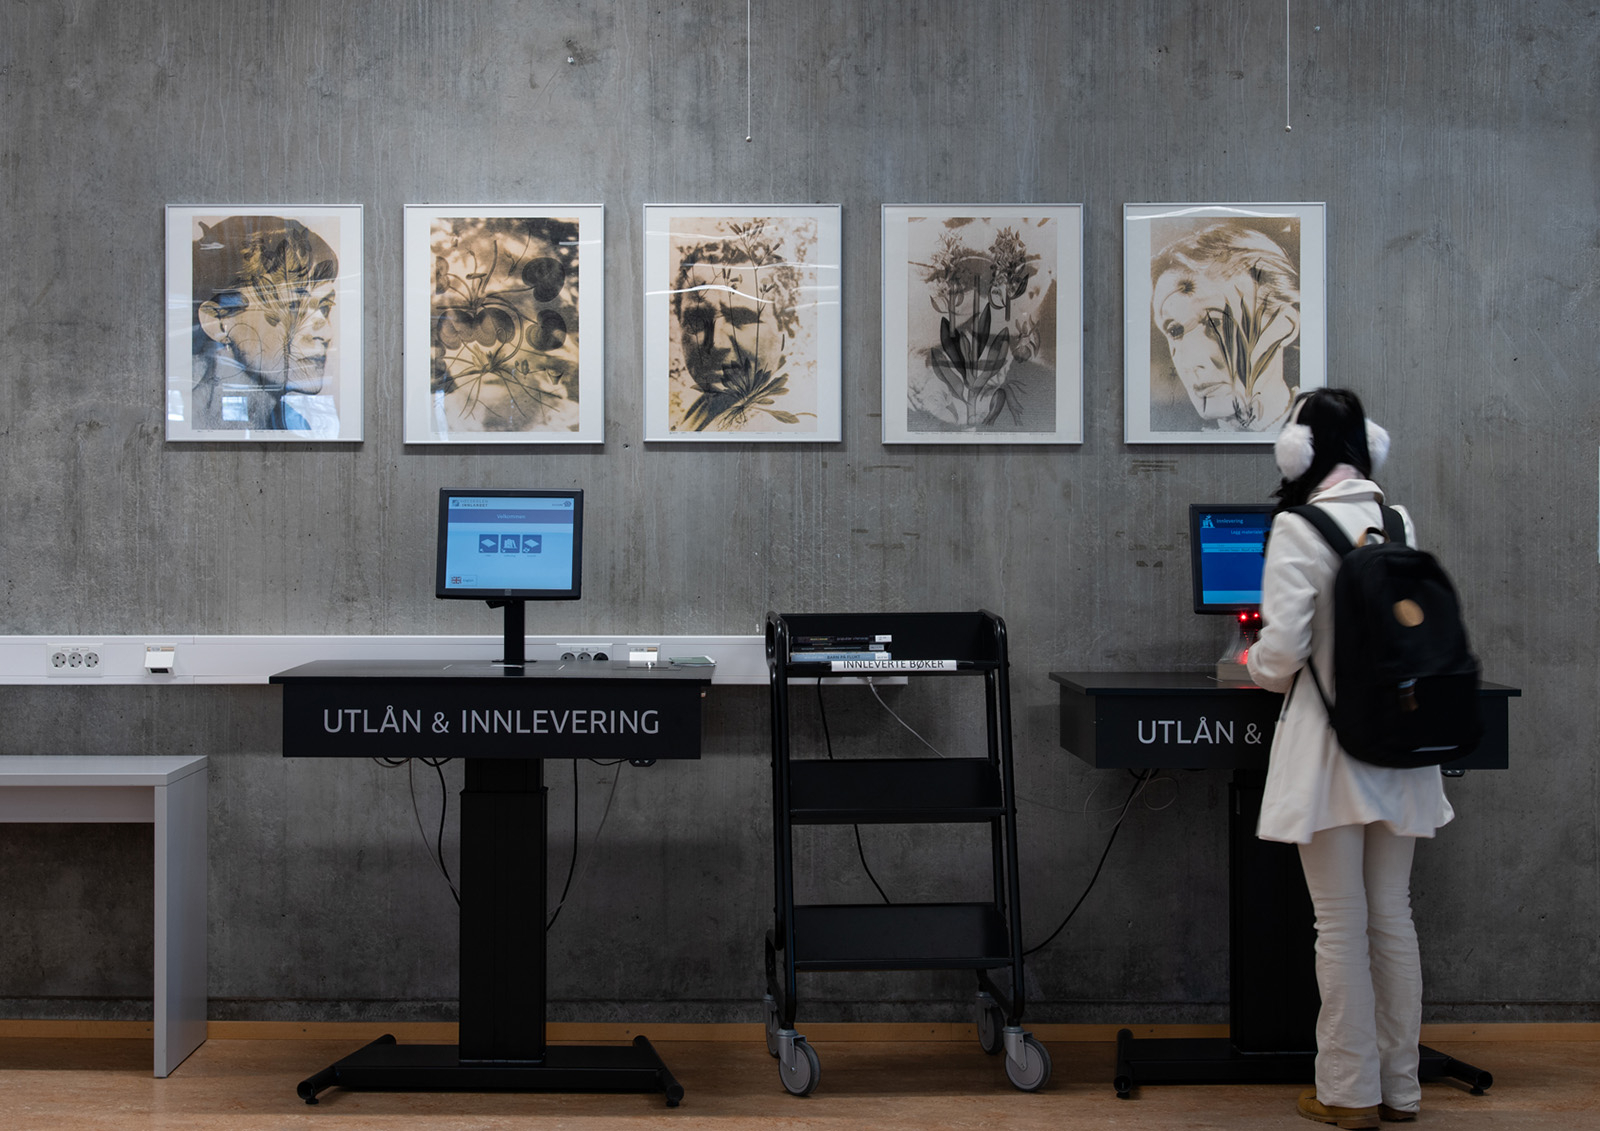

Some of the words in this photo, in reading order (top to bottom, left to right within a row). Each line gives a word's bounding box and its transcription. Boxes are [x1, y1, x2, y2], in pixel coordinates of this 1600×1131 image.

[843, 660, 906, 669] INNLEVERTE
[909, 660, 944, 669] BØKER
[323, 704, 421, 734] UTLÅN
[431, 712, 450, 734] &
[461, 708, 660, 735] INNLEVERING
[1137, 716, 1234, 744] UTLÅN
[1244, 723, 1262, 744] &
